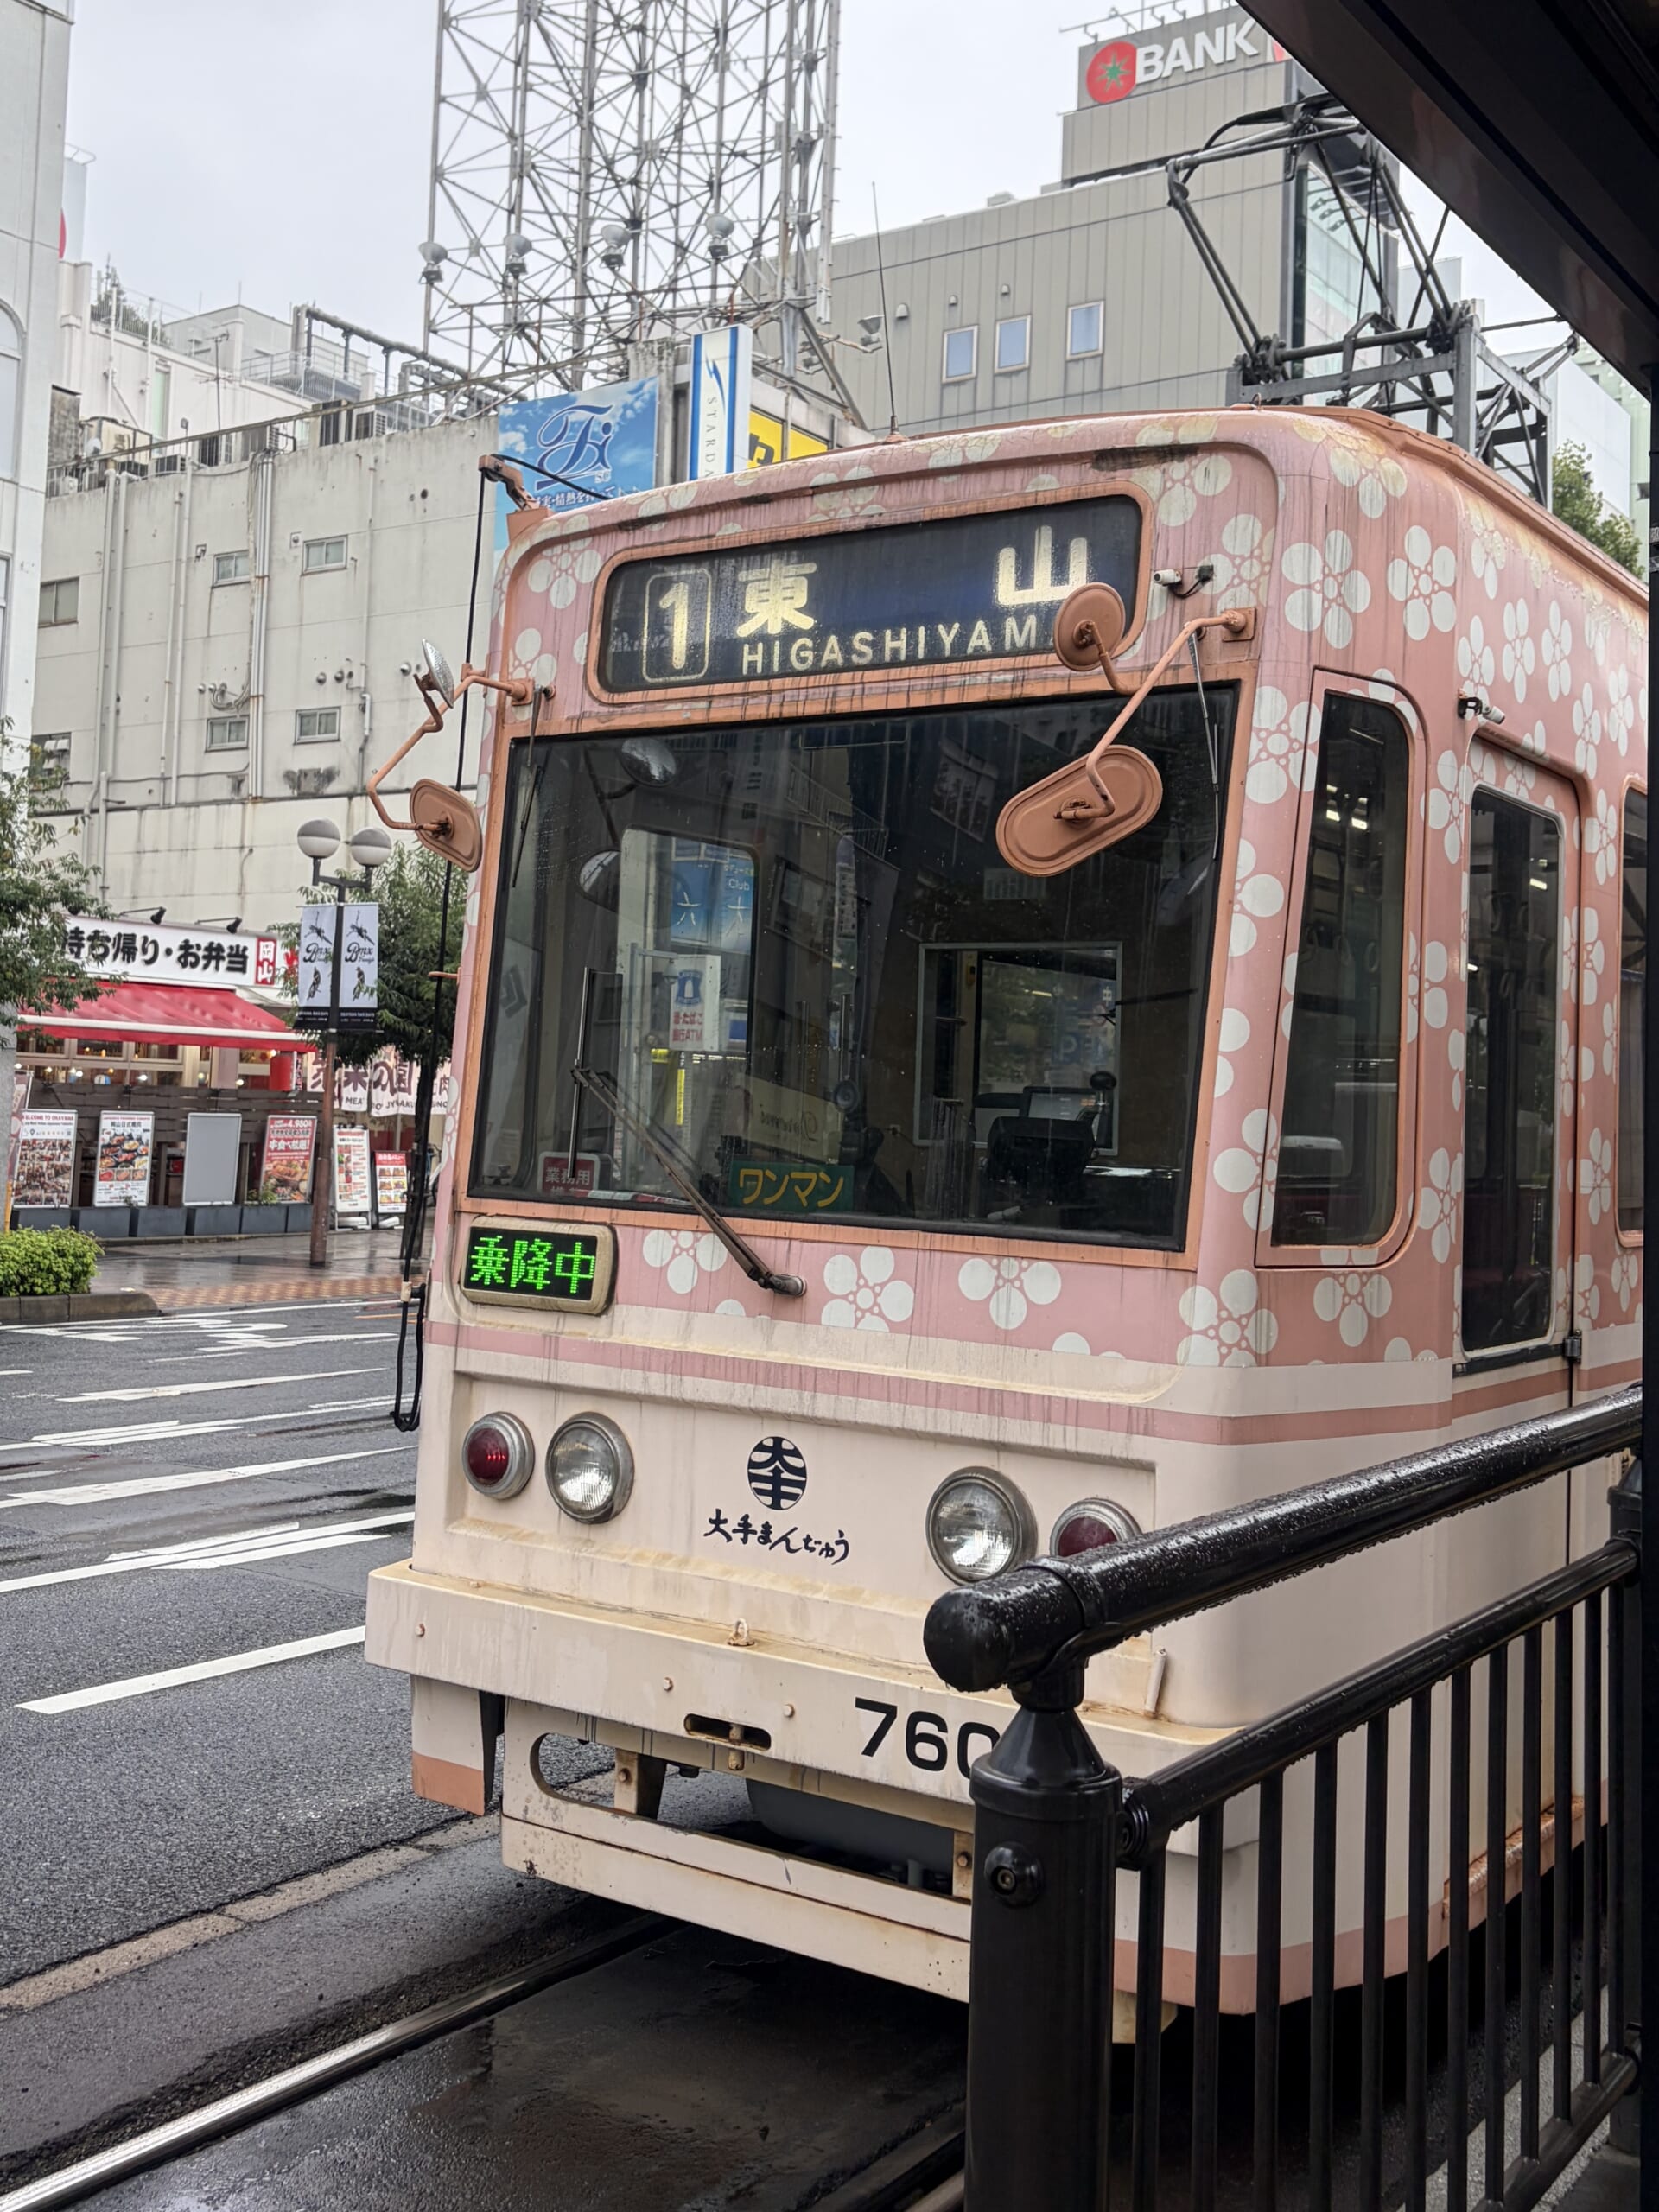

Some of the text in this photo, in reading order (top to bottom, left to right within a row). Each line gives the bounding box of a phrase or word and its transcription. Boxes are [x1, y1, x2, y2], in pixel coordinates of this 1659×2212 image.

[1135, 19, 1260, 86] BANK
[659, 582, 690, 671] 1
[742, 614, 1055, 676] HIGASHIYAM
[545, 1166, 590, 1185] 業務用
[740, 1168, 844, 1208] ワンマン
[470, 1235, 596, 1294] 乗降中
